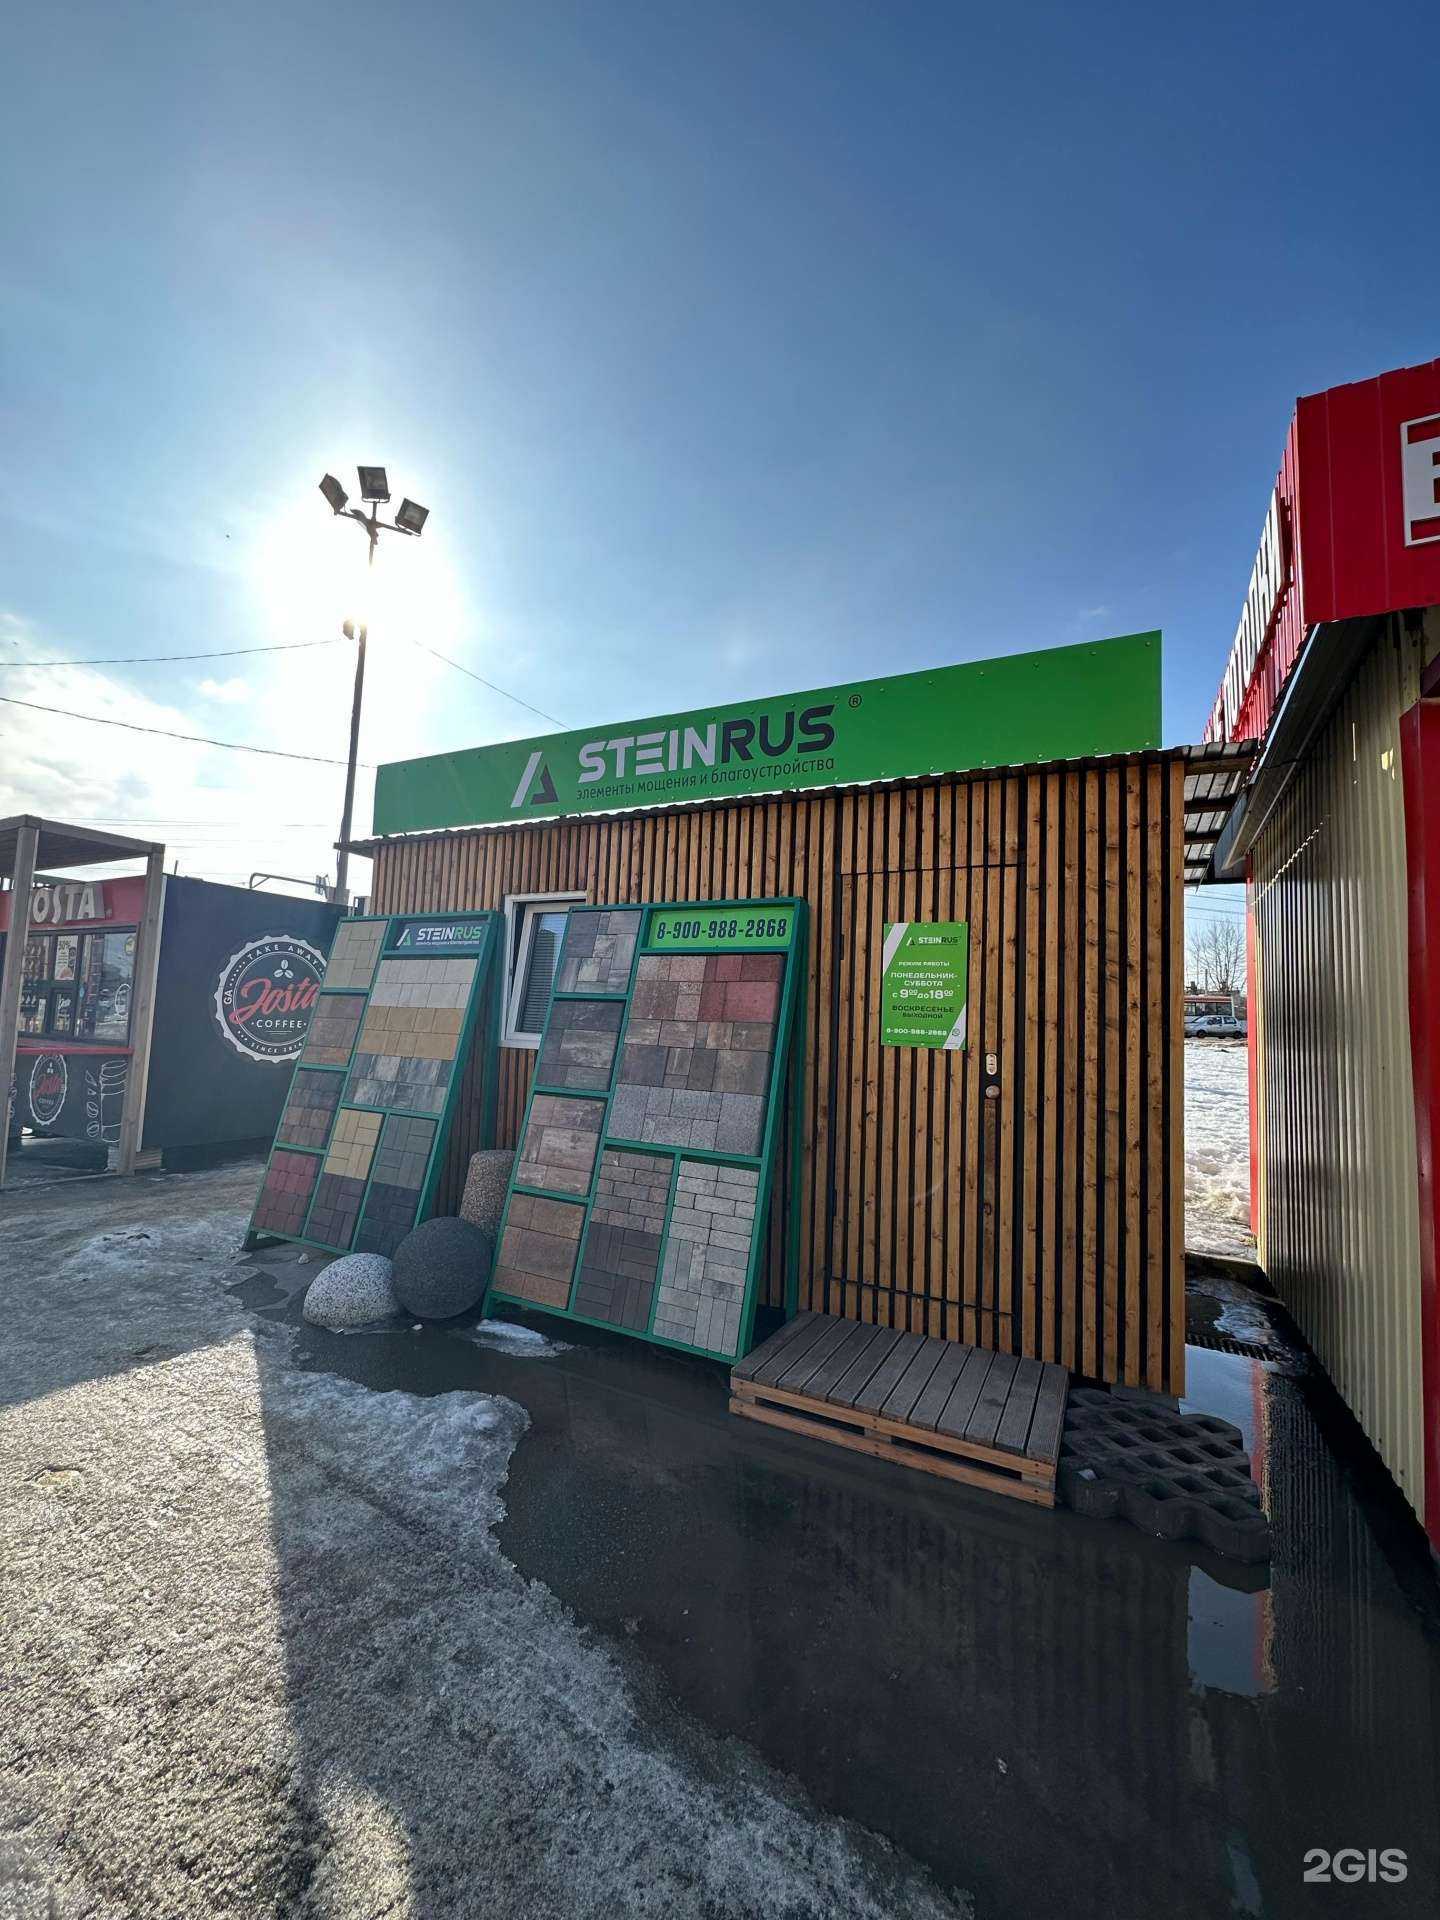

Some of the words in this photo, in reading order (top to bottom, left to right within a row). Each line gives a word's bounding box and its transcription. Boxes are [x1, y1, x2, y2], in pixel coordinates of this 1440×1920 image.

[578, 704, 835, 783] STEINRUS
[576, 784, 635, 800] элементы
[638, 773, 697, 793] мощения
[700, 775, 707, 785] и
[711, 757, 834, 784] благоустройства
[416, 926, 482, 941] STEINRUS
[656, 918, 787, 939] 8-900-988-2868
[918, 936, 959, 944] STEINRUS
[247, 944, 279, 960] TAKE
[288, 945, 319, 965] AWAY
[892, 1005, 954, 1013] ВОСКРЕСЕНЬЕ
[256, 1019, 303, 1028] COFFEE
